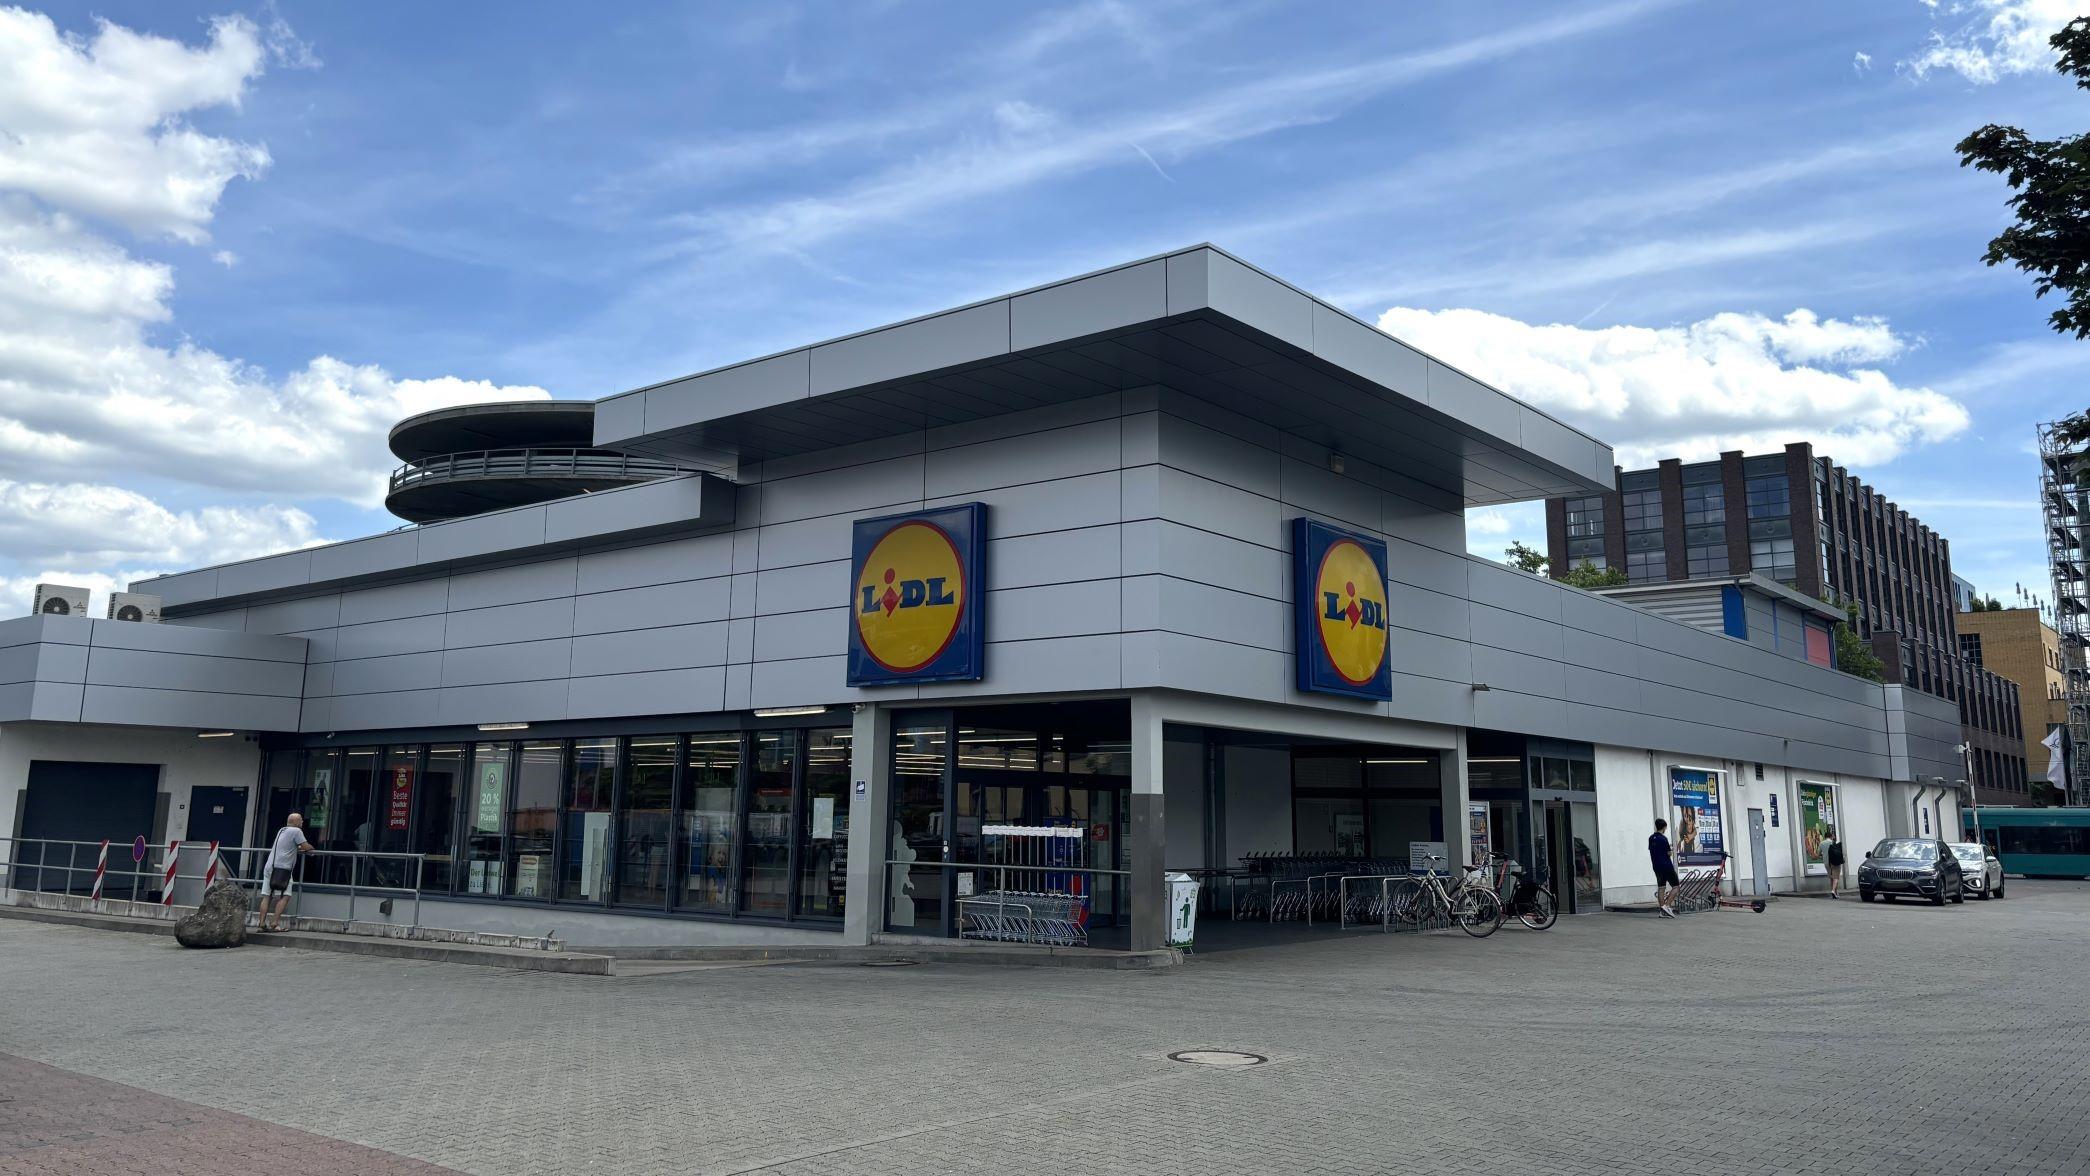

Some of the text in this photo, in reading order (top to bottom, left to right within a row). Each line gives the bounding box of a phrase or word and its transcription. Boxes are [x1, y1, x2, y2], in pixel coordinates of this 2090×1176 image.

[393, 791, 407, 800] Beste
[481, 793, 499, 805] 20 %
[480, 813, 498, 822] Plastik
